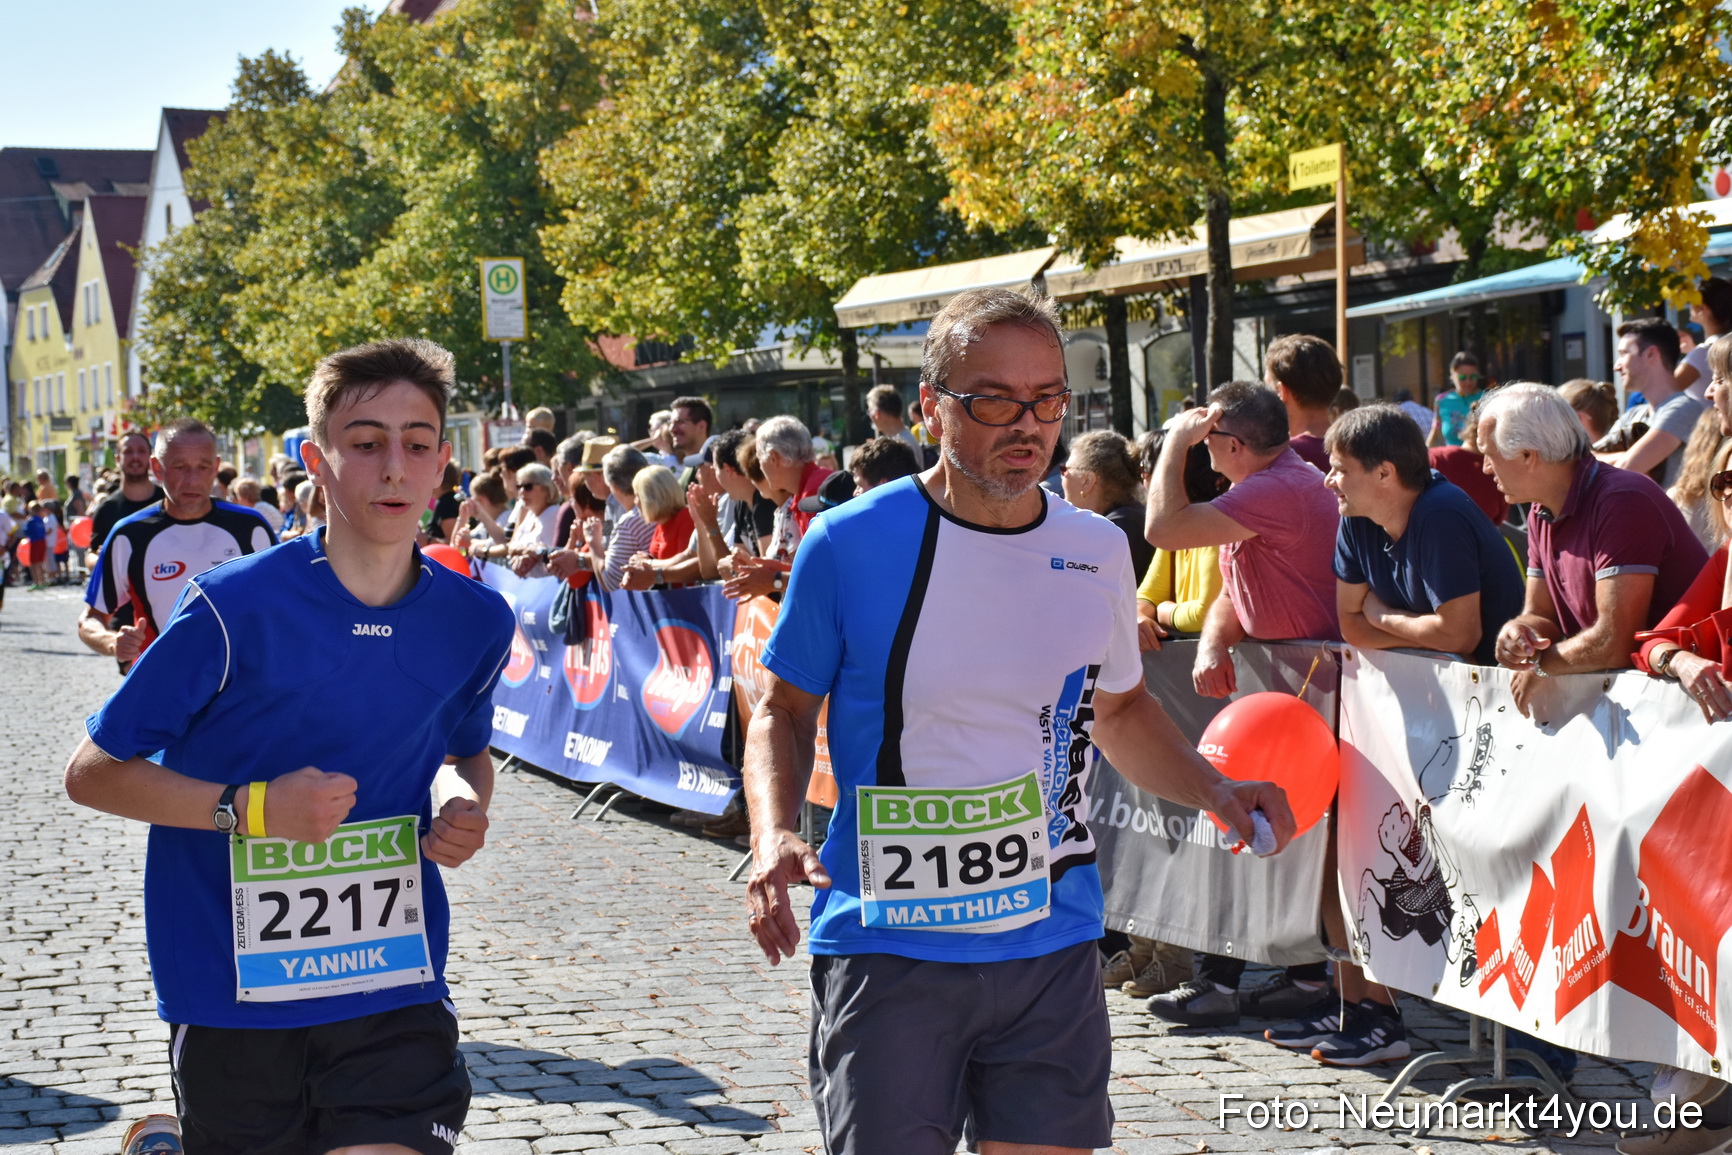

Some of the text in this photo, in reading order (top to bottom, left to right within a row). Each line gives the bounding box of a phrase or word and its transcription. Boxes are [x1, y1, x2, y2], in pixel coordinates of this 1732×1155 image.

[1299, 158, 1338, 178] Toiletten
[153, 563, 177, 575] tkn
[351, 623, 393, 638] JAKO
[1039, 704, 1052, 744] WSTE
[677, 760, 697, 791] GET
[874, 785, 1030, 827] BOCK
[249, 827, 404, 873] BOCK
[1032, 831, 1040, 840] D
[882, 833, 1029, 890] 2189
[406, 880, 414, 888] D
[258, 877, 400, 942] 2217
[886, 889, 1030, 925] MATTHIAS
[1552, 912, 1598, 991] Braun
[1618, 877, 1710, 1006] Braun
[279, 946, 388, 979] YANNIK
[1567, 968, 1583, 988] Sicher
[1658, 966, 1682, 997] Sicher
[1684, 990, 1695, 1009] ist
